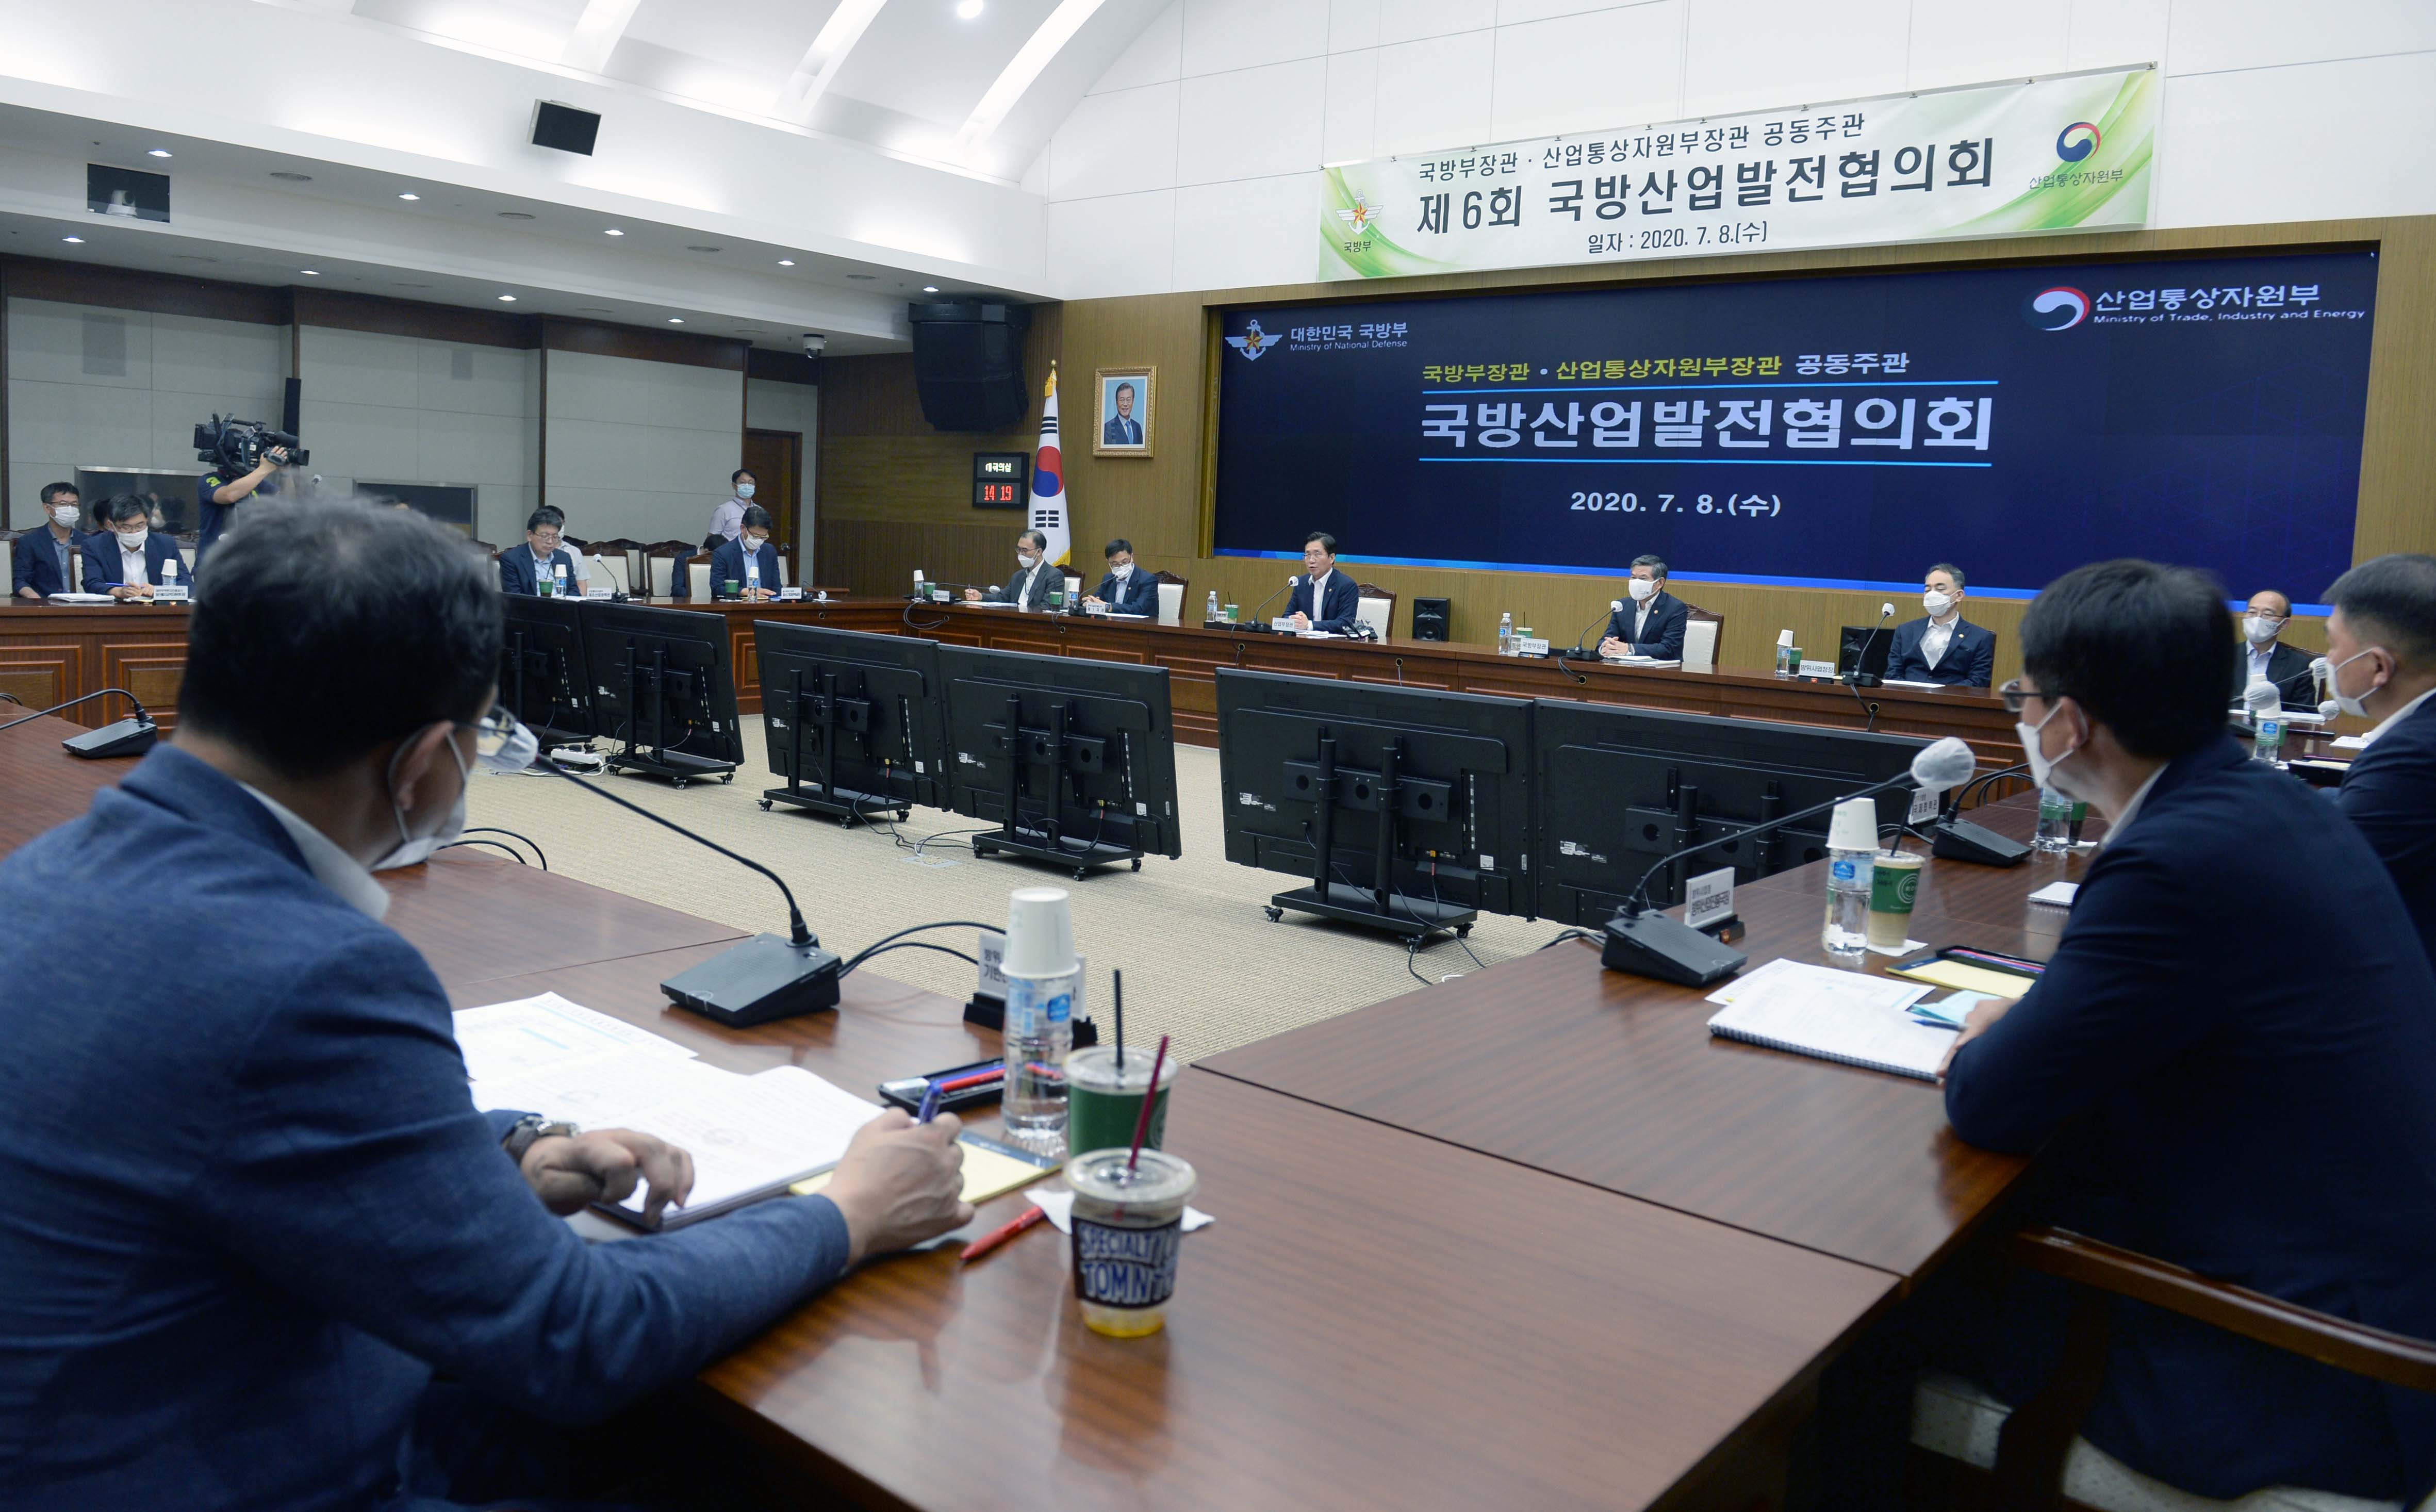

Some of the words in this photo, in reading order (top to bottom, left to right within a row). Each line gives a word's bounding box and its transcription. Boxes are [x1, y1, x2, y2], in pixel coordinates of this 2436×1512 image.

[1419, 152, 1518, 182] 국방부장관
[1543, 125, 1750, 169] 산업통상자원부장관
[1764, 112, 1865, 146] 공동주관
[1549, 137, 1993, 222] 국방산업발전협의회
[2030, 169, 2124, 189] 산업통상자원부
[1343, 240, 1372, 253] 국방부
[1588, 233, 1623, 254] 일자
[1640, 228, 1688, 249] 2020.
[1697, 226, 1711, 245] 7.
[1719, 221, 1767, 244] 8.(수)
[2096, 285, 2320, 311] 산업통상자원부
[2094, 315, 2147, 324] Ministry
[2150, 314, 2164, 322] of
[2169, 313, 2213, 322] Trade,
[2218, 311, 2275, 321] Industry
[2314, 309, 2365, 319] Energy
[1291, 325, 1353, 342] 대한민국
[1359, 322, 1408, 339] 국방부
[1290, 343, 1322, 352] Ministry
[1324, 342, 1332, 350] of
[1335, 341, 1369, 350] National
[1372, 340, 1408, 349] Defense
[1422, 363, 1530, 383] 국방부장관
[1556, 356, 1782, 380] 산업통상자원부장관
[1795, 353, 1910, 375] 공동주관
[1422, 397, 1993, 450] 국방산업발전협의회
[1570, 492, 1647, 512] 2020.
[1658, 494, 1684, 513] 7.
[1696, 494, 1781, 517] 8.(수)
[1801, 664, 1834, 673] 방위사업청장
